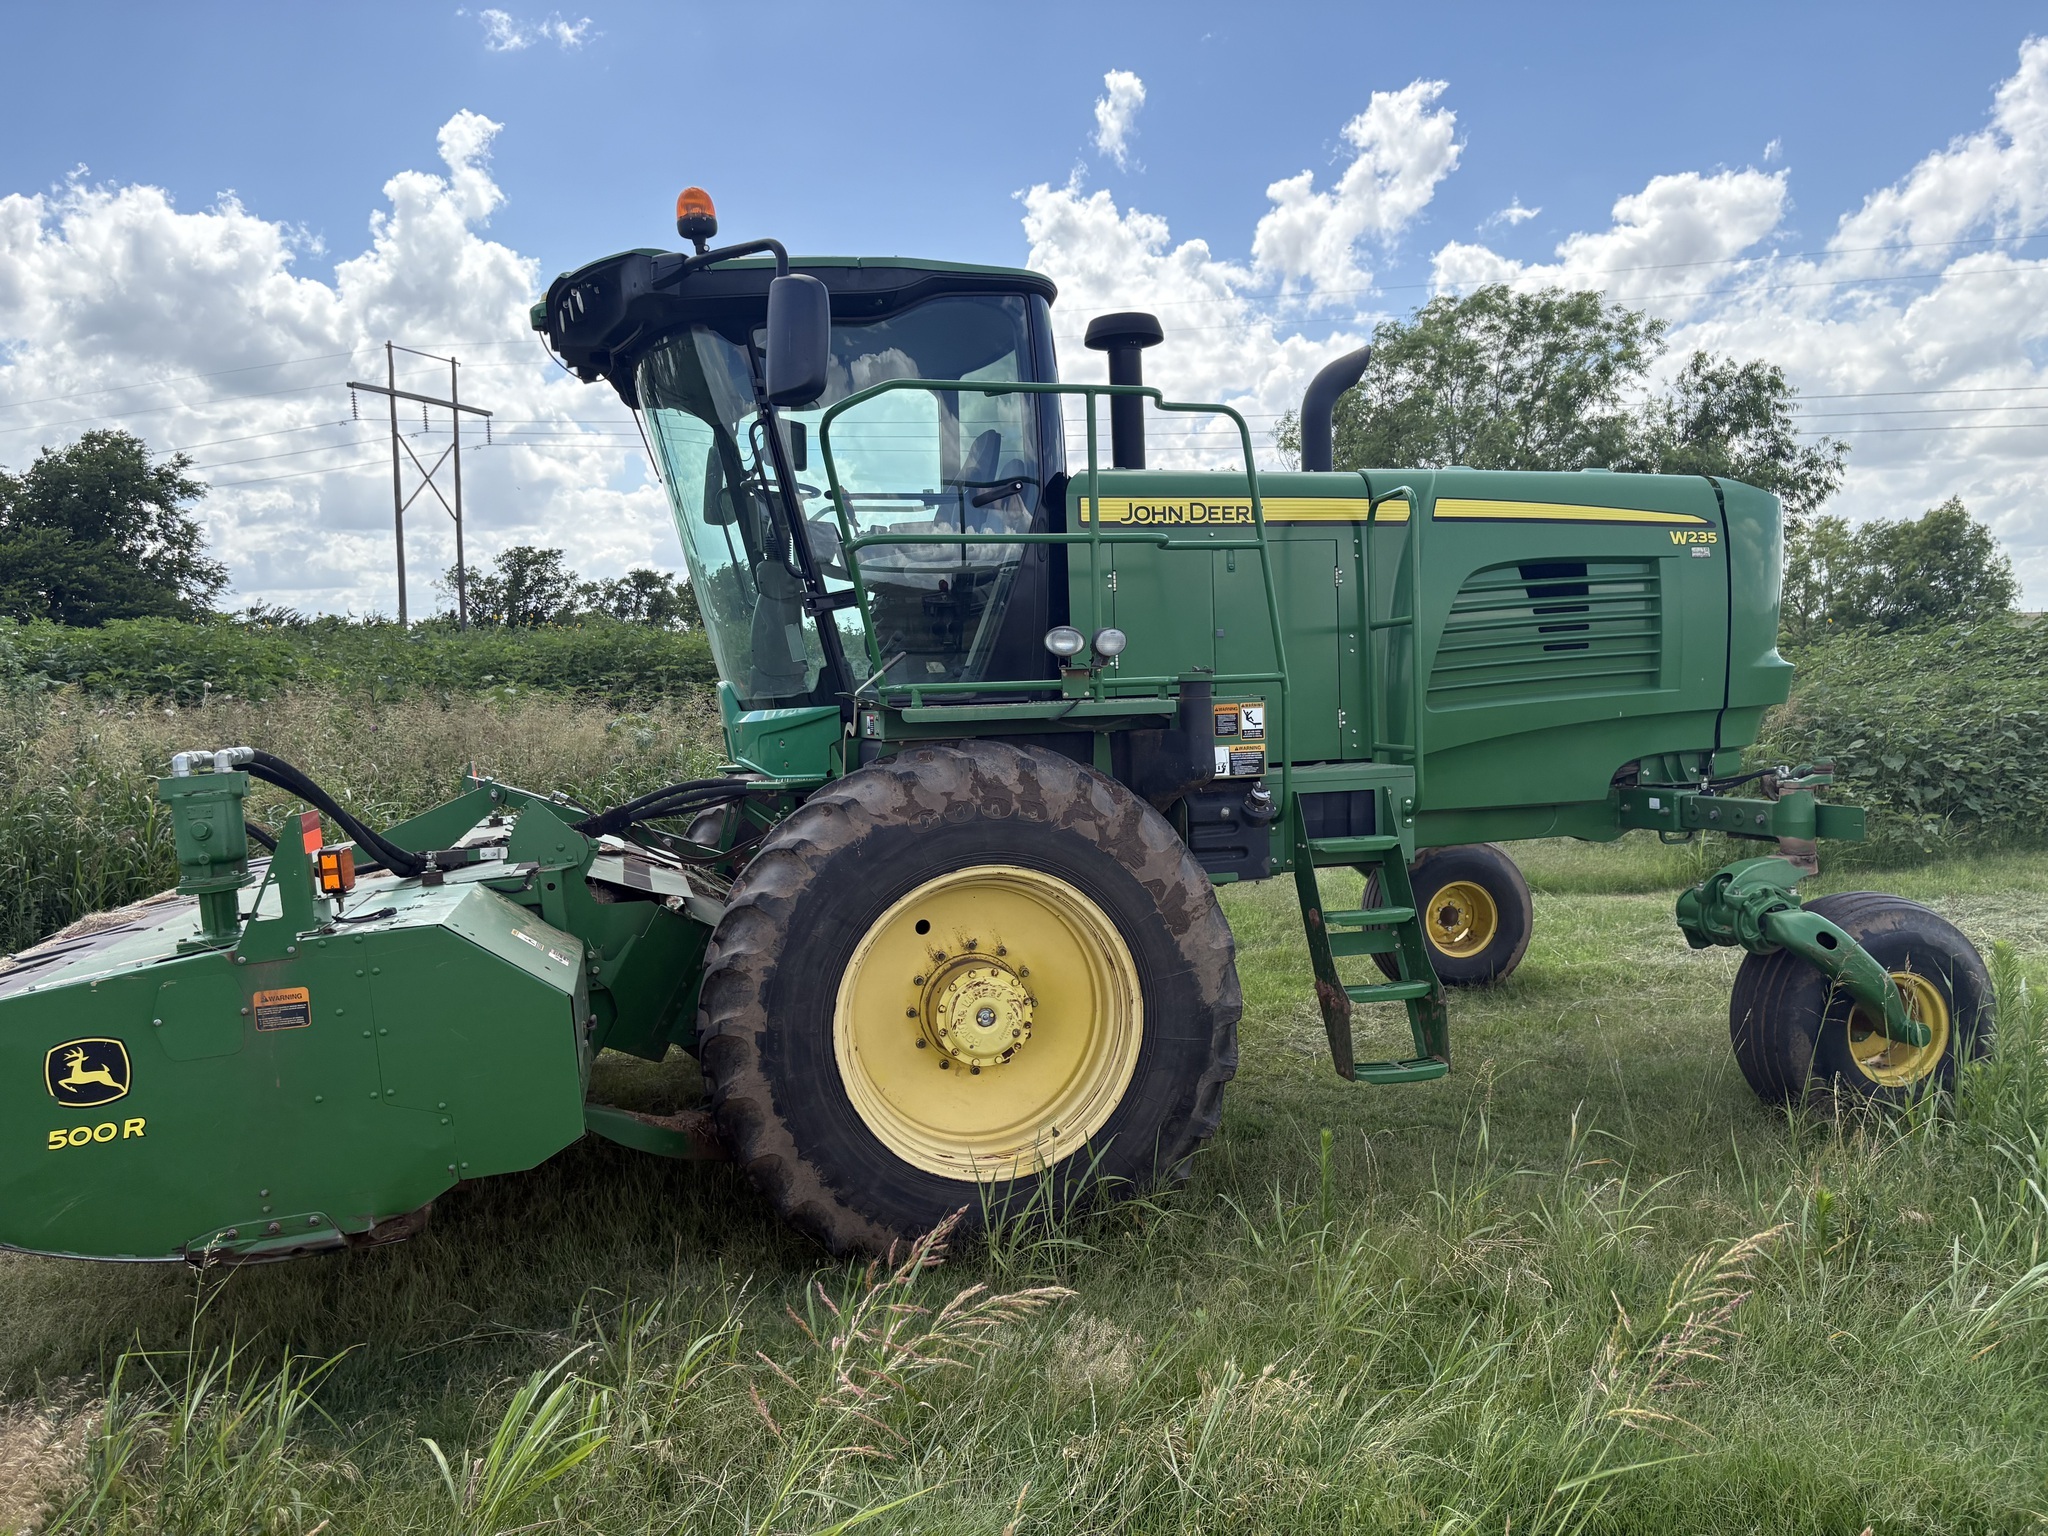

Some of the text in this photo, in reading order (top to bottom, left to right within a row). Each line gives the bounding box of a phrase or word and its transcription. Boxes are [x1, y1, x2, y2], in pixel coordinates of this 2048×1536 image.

[1120, 502, 1183, 522] JOHN
[1669, 530, 1718, 545] W235
[268, 993, 303, 1002] WARNING
[48, 1117, 146, 1150] 500 R
